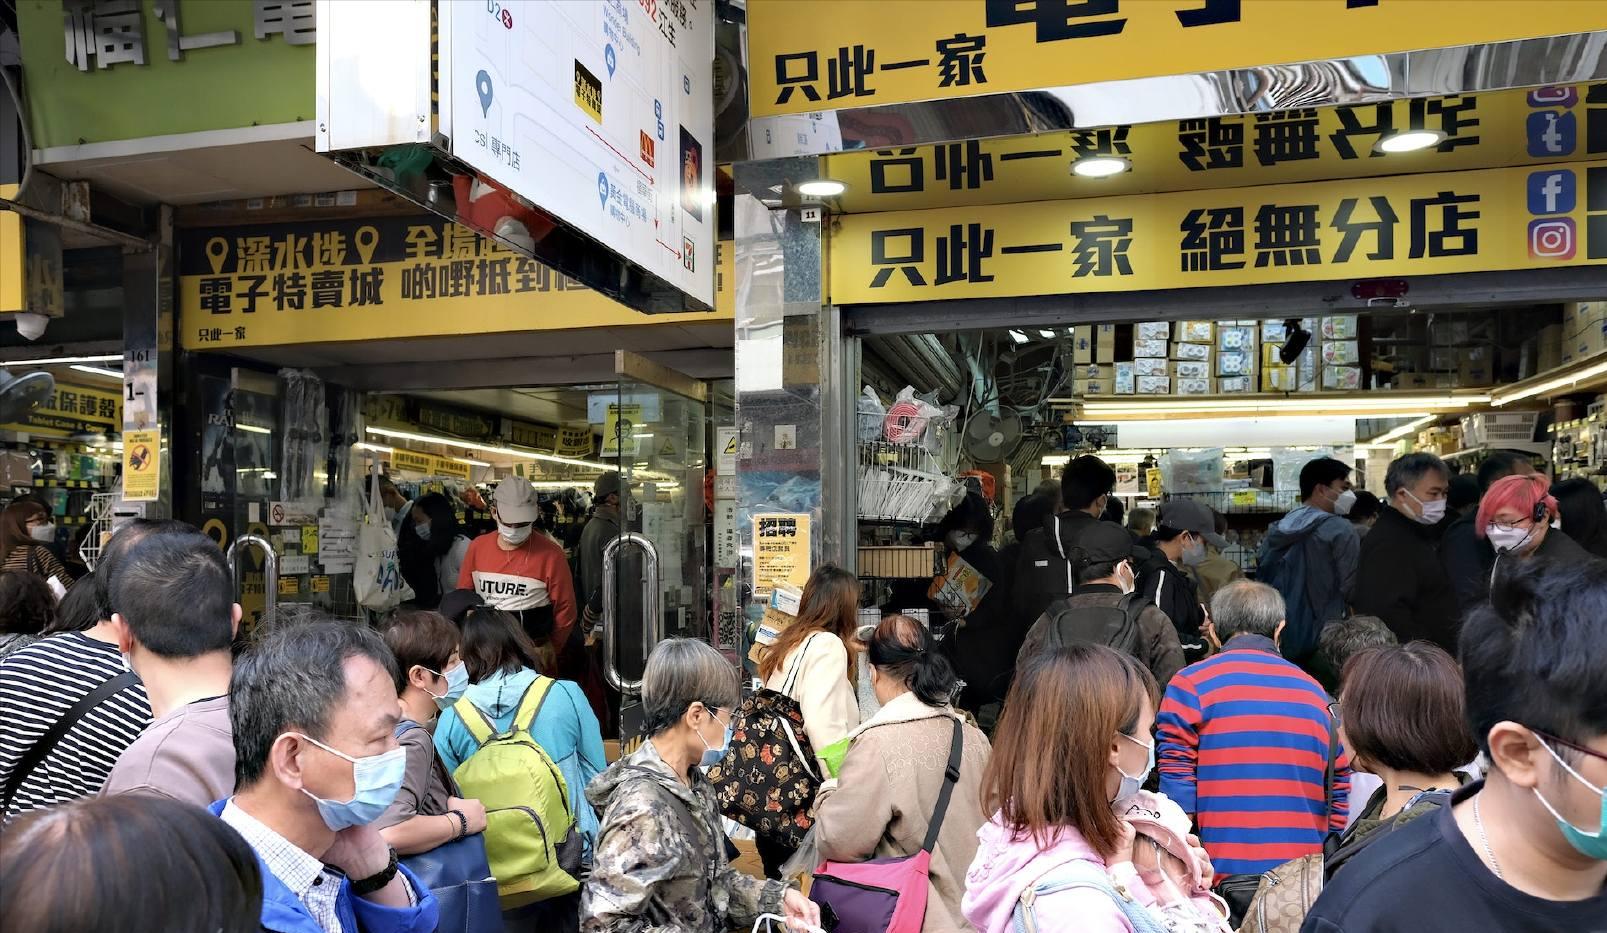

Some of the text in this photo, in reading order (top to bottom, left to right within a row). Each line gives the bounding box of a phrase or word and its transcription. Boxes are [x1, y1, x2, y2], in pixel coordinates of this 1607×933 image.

[775, 33, 988, 105] 只此一家
[805, 210, 816, 219] 11
[1180, 191, 1480, 272] 絕無分店
[236, 231, 347, 272] 深水埗
[869, 215, 1134, 288] 只此一家
[200, 267, 384, 315] 電子特賣城
[198, 327, 246, 342] 只此一家
[758, 517, 797, 538] 招聘
